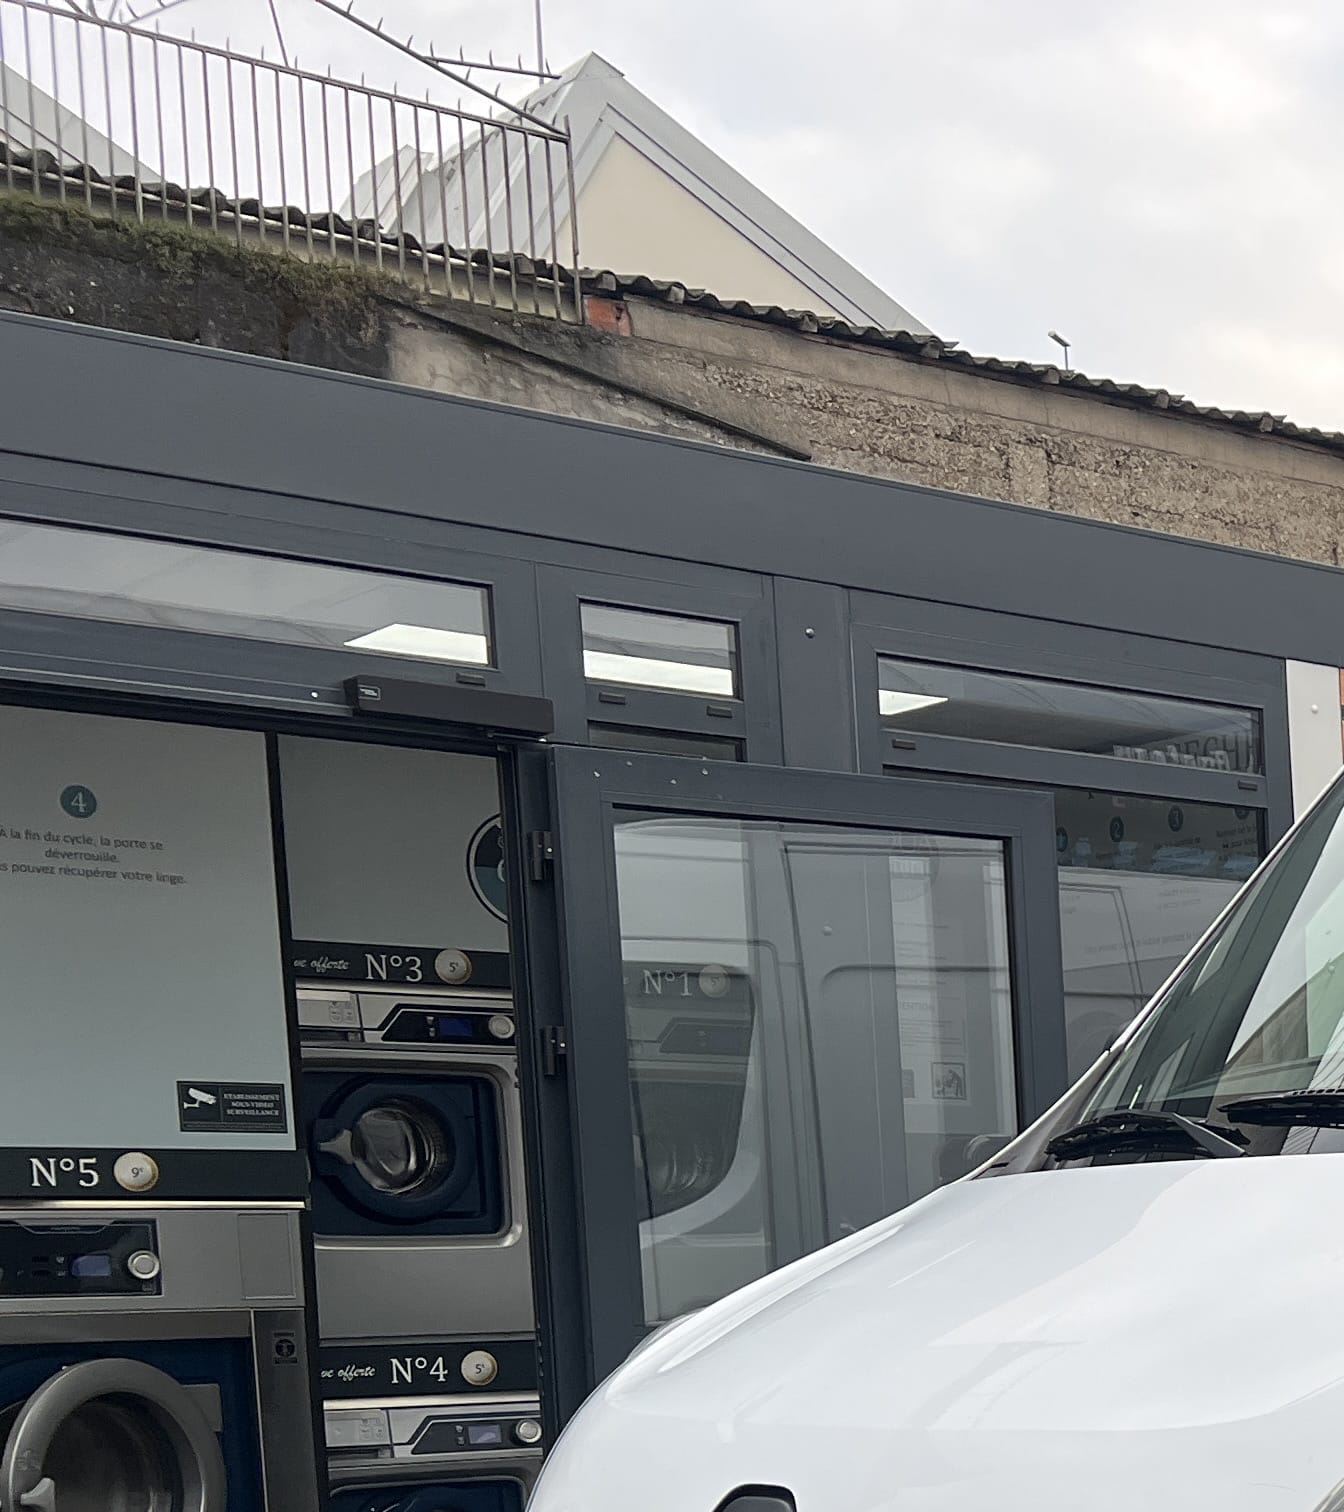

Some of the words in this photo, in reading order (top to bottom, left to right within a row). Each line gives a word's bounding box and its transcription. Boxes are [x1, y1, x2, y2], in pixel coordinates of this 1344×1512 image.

[70, 791, 87, 813] 4
[10, 828, 21, 840] la
[24, 829, 40, 841] fin
[44, 831, 60, 843] du
[100, 835, 111, 847] la
[114, 839, 147, 849] porte
[150, 841, 163, 850] se
[12, 863, 56, 875] pouvez
[59, 866, 117, 879] récupérer
[120, 871, 153, 881] votre
[365, 953, 423, 983] N°3
[643, 969, 693, 996] N°1
[29, 1156, 99, 1188] N°5
[390, 1356, 449, 1384] N°4
